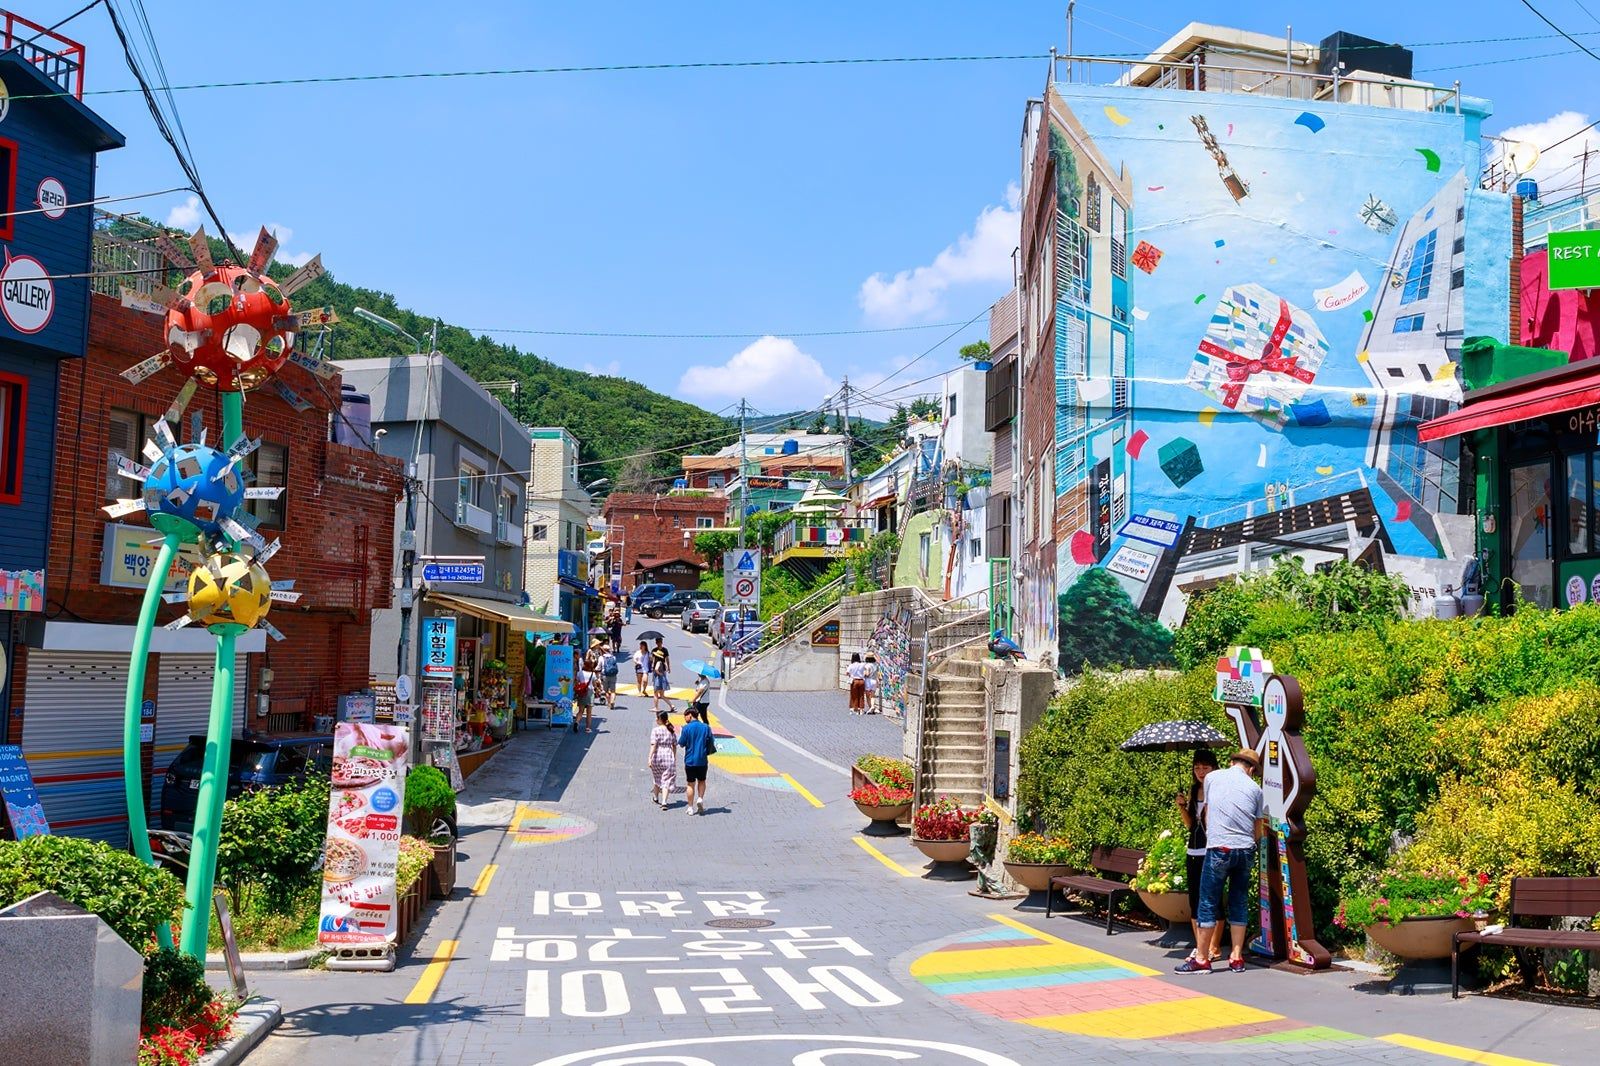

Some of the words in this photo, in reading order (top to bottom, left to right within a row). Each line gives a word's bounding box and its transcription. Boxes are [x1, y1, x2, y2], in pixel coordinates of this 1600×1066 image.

[41, 189, 65, 207] 갤러리
[1552, 245, 1592, 260] REST
[3, 280, 51, 311] GALLERY
[124, 554, 150, 578] 백양
[740, 583, 750, 592] 30
[430, 621, 448, 664] 체험장
[0, 773, 29, 783] MAGNET
[328, 881, 353, 895] 바다가
[337, 889, 360, 904] 보이는
[355, 909, 383, 919] coffee
[489, 925, 874, 962] 보호구역
[524, 965, 904, 1018] 어린이
